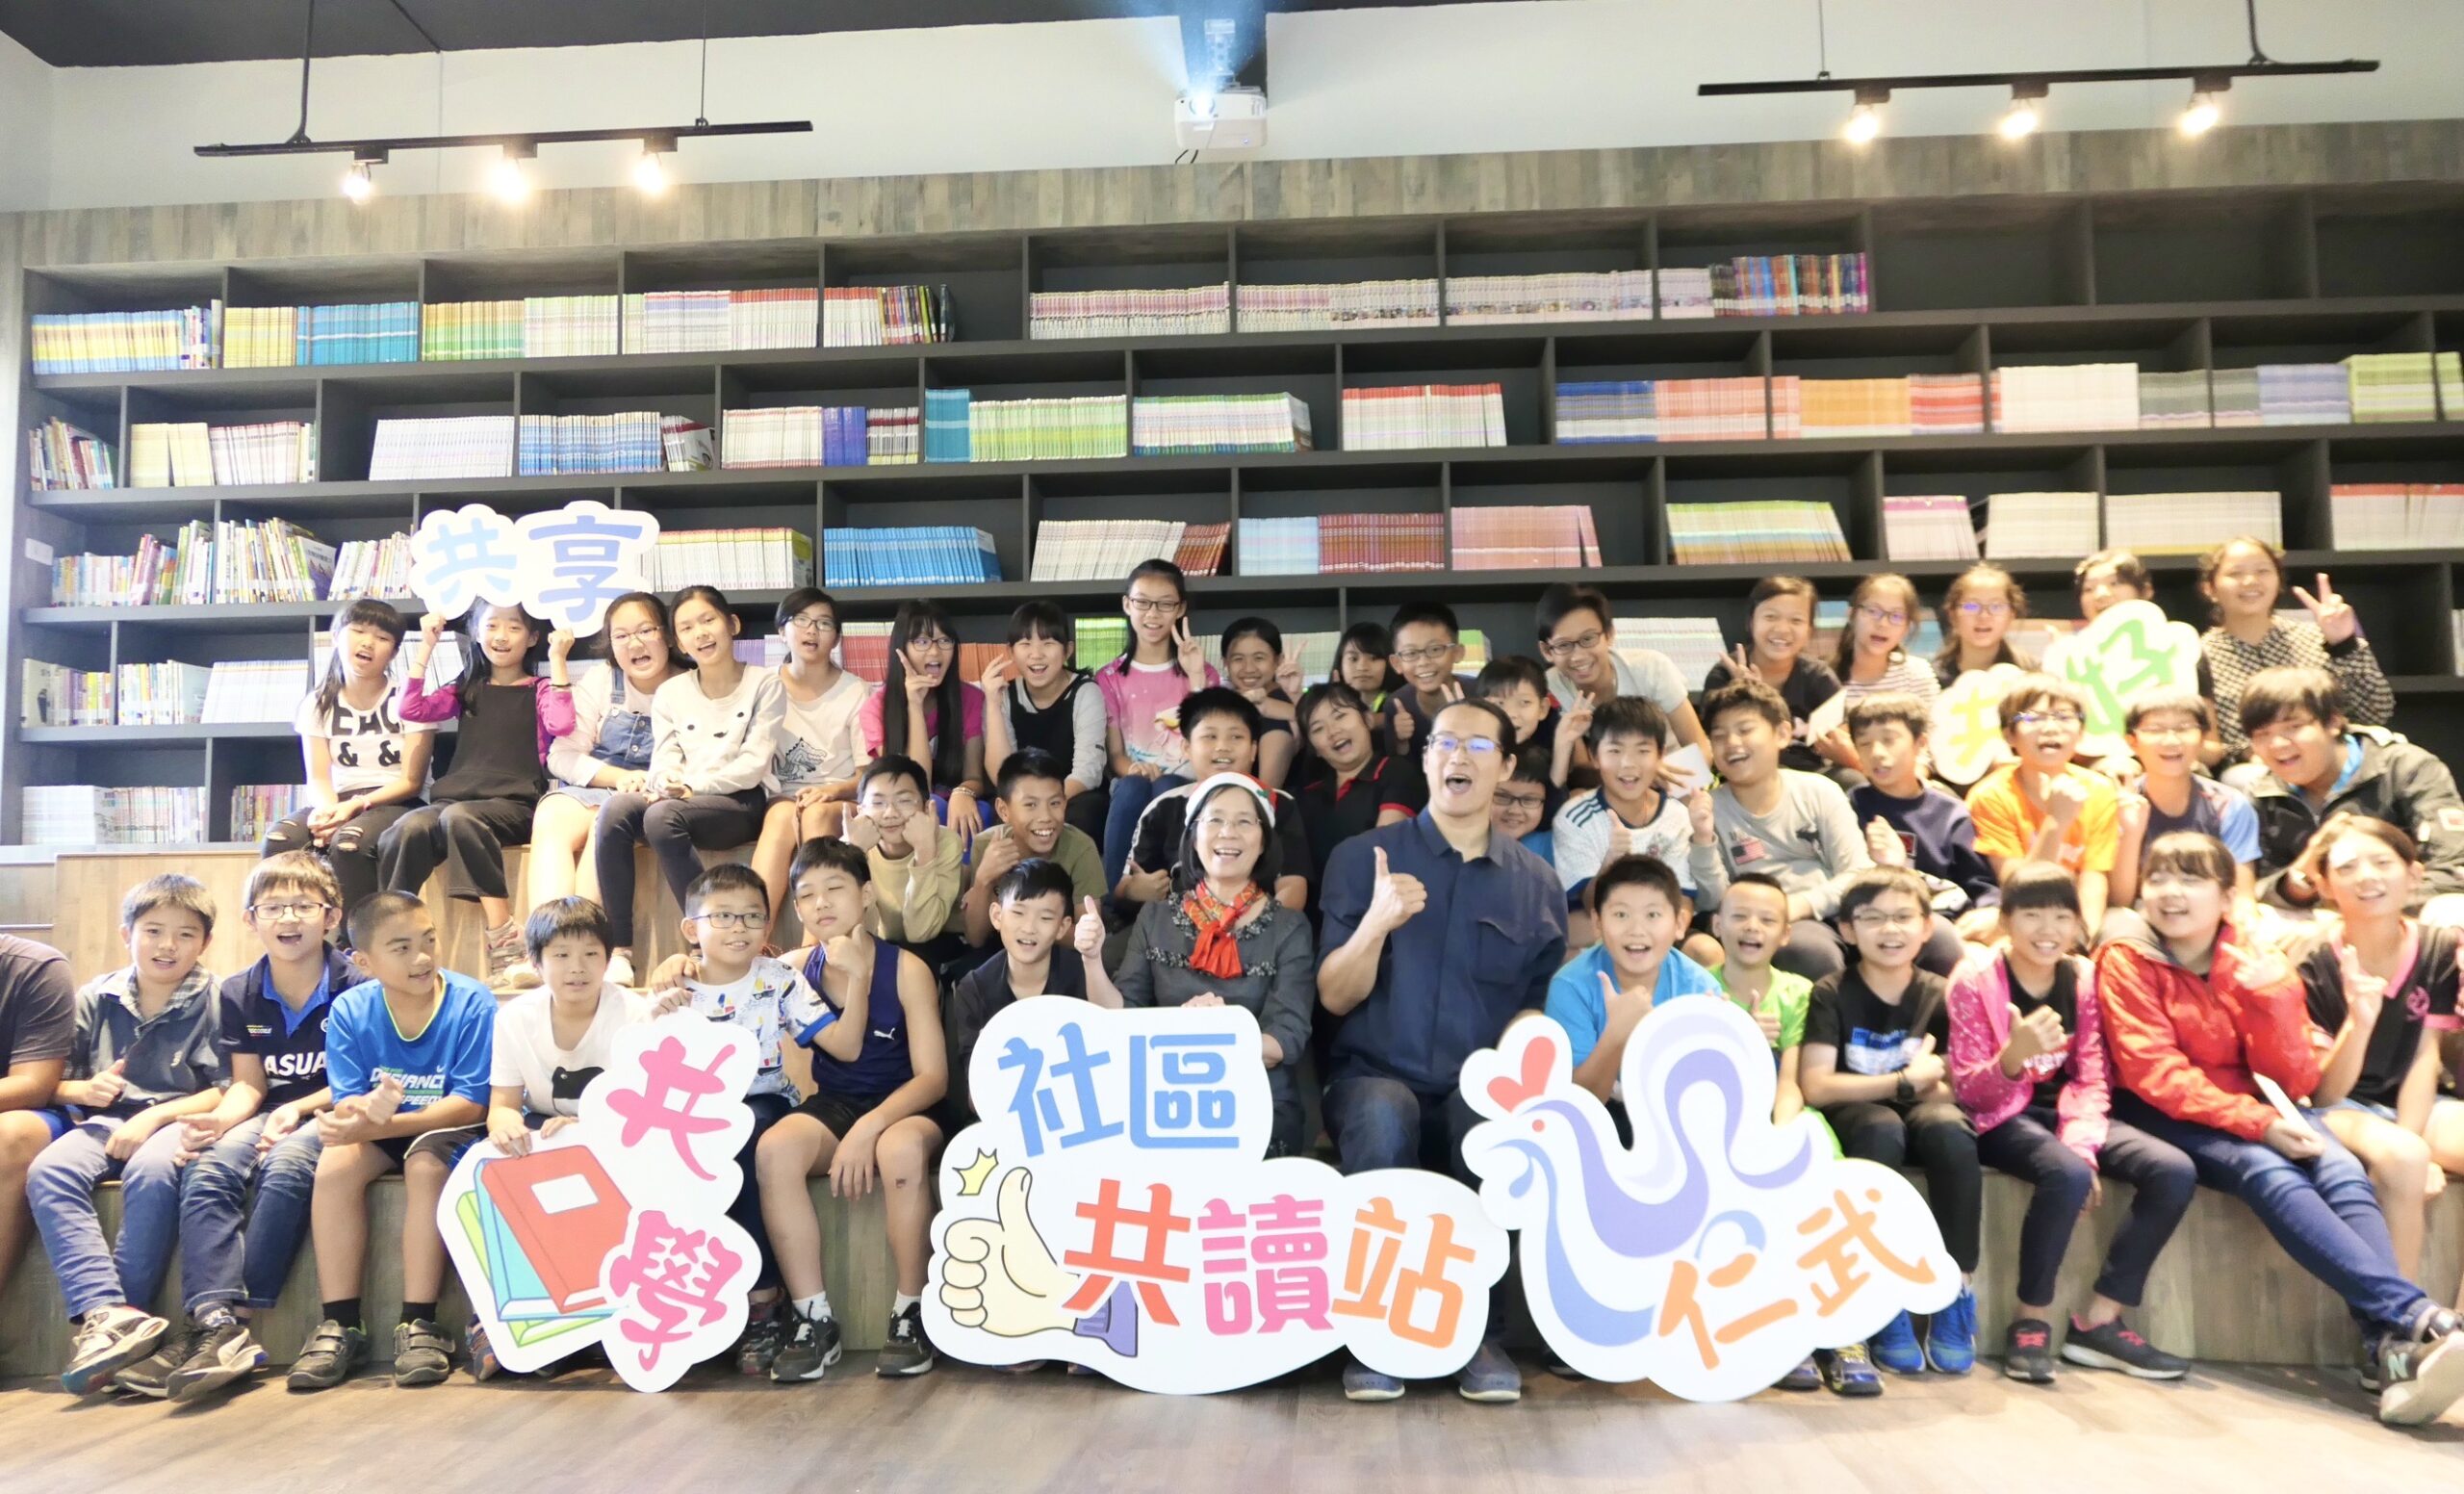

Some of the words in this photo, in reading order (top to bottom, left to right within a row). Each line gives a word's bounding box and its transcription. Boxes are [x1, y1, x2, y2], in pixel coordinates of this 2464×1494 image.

[424, 515, 643, 622] 共享
[337, 741, 360, 767] &
[378, 739, 401, 767] &
[997, 1022, 1240, 1158] 社區
[607, 1037, 742, 1371] 共學
[1061, 1178, 1476, 1349] 共讀站
[1657, 1188, 1937, 1371] 仁武
